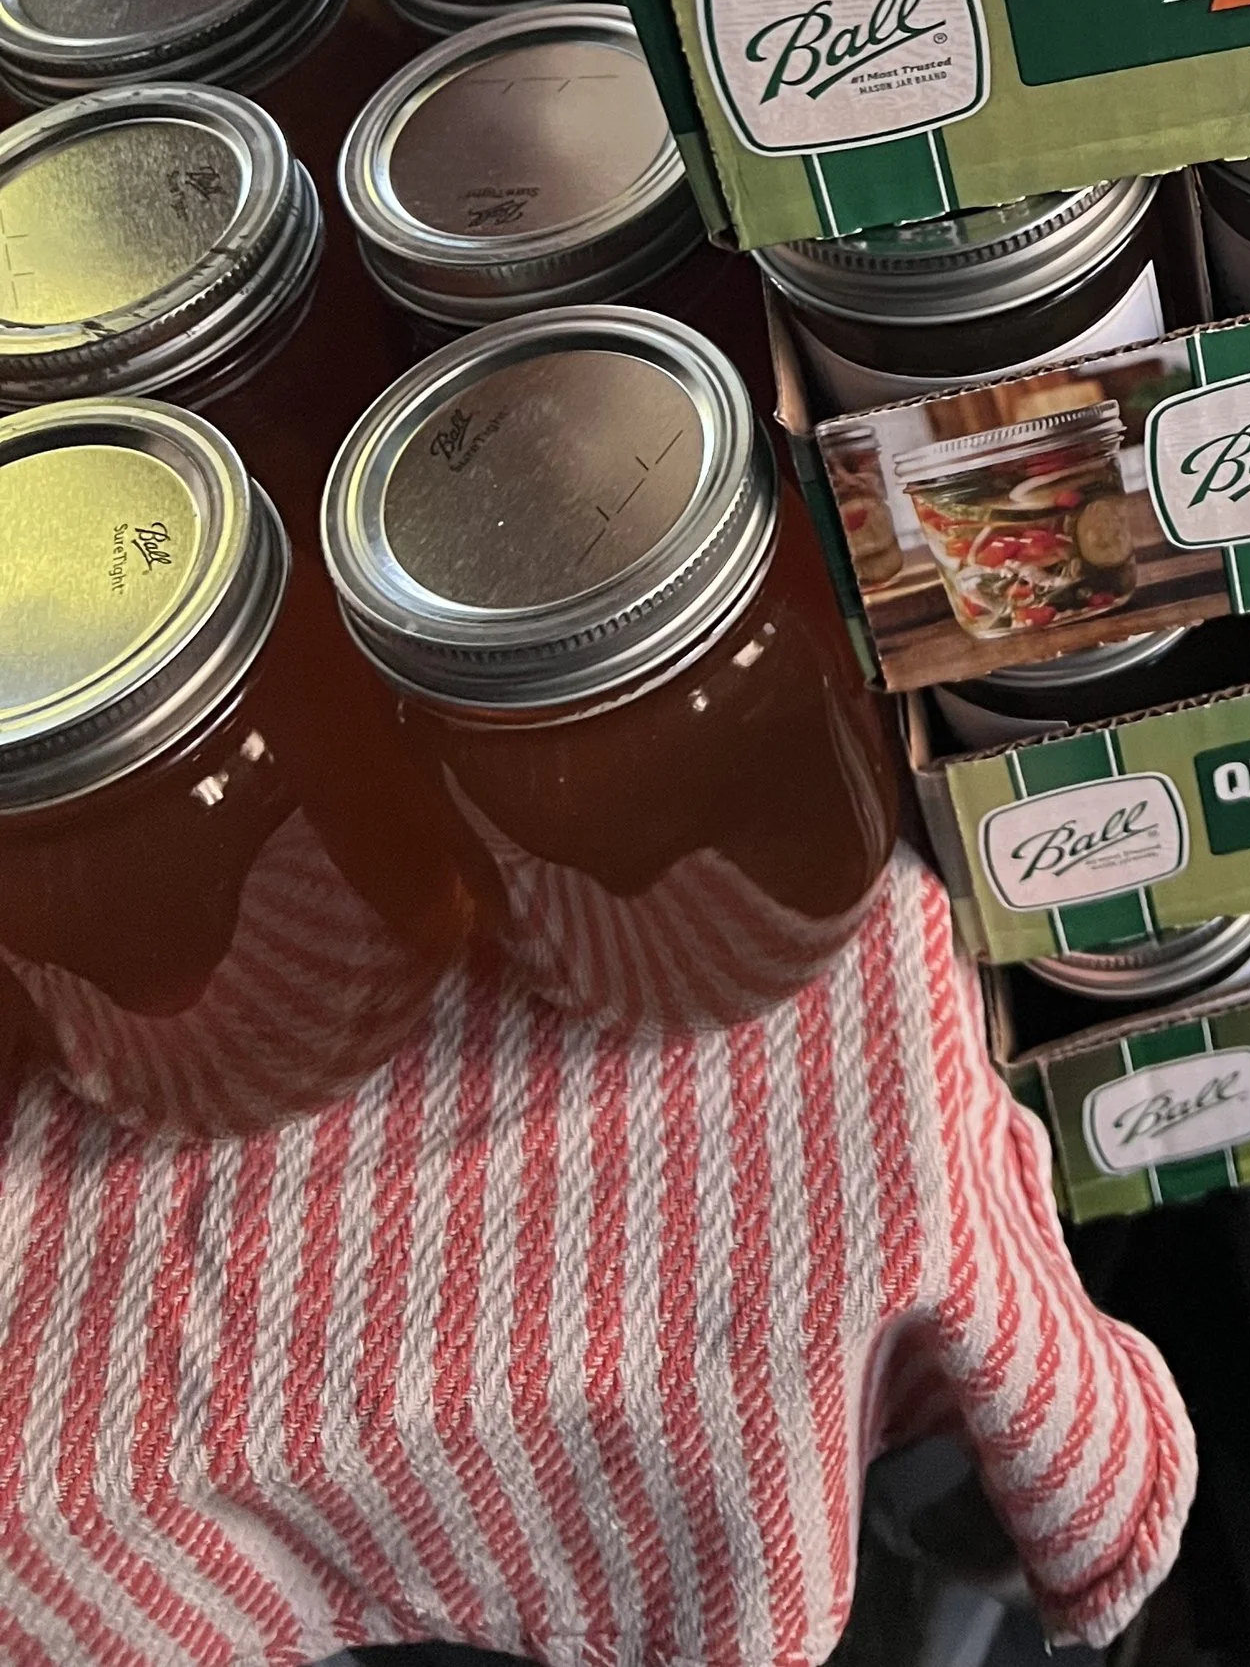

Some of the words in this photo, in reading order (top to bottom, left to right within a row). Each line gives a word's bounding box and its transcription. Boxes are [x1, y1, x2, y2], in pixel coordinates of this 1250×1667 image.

[859, 82, 893, 94] MASON
[915, 71, 947, 84] BRAND
[867, 69, 898, 81] Most
[901, 57, 952, 74] Trusted
[430, 408, 473, 460] Ball
[109, 523, 129, 595] SureTight
[131, 521, 172, 571] Ball
[1011, 800, 1159, 881] Ball
[1113, 1071, 1249, 1145] Ball
